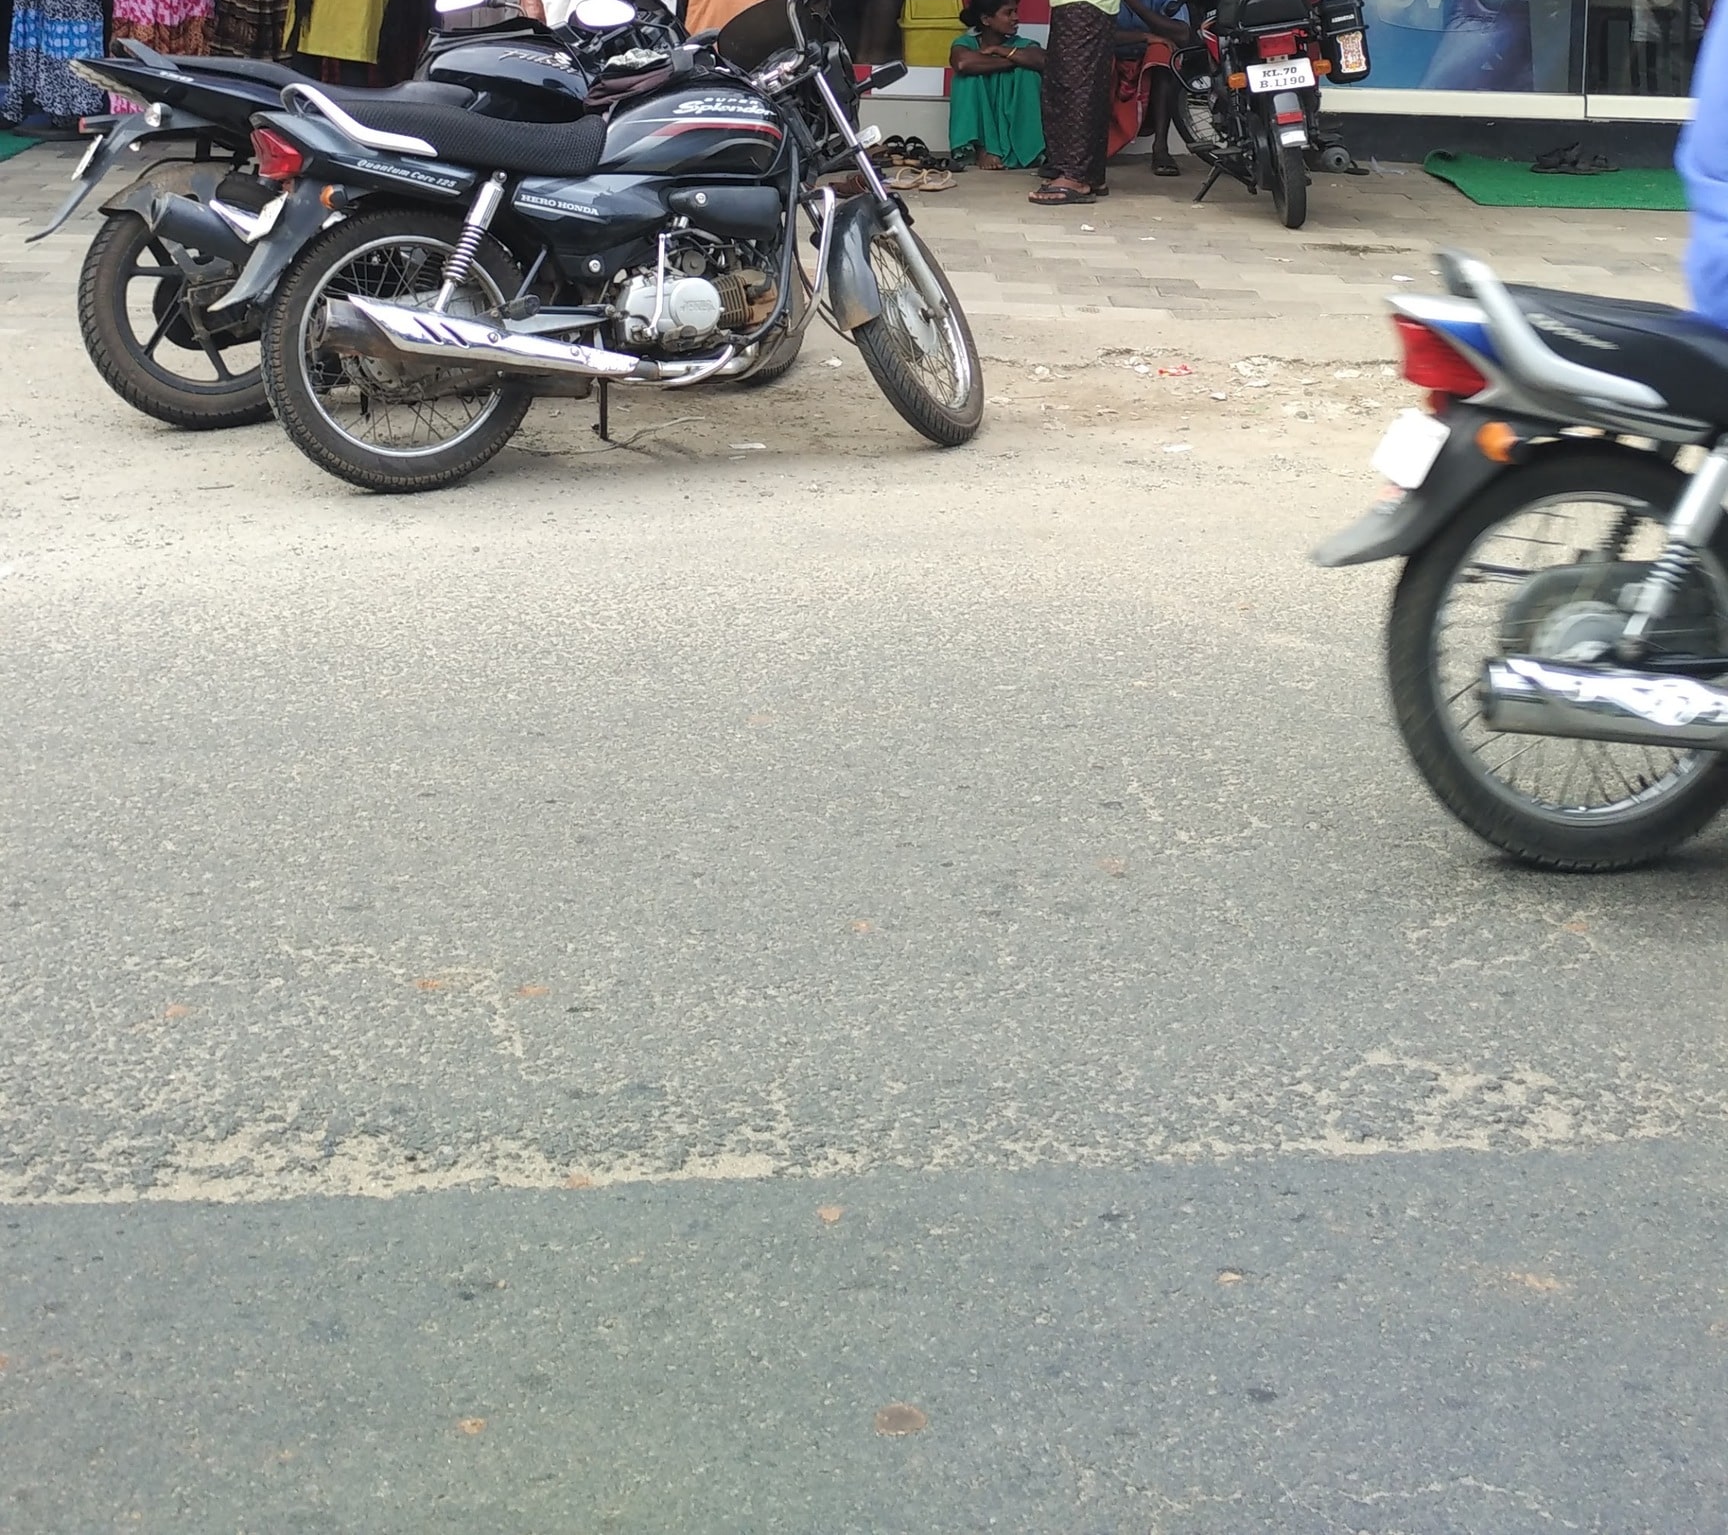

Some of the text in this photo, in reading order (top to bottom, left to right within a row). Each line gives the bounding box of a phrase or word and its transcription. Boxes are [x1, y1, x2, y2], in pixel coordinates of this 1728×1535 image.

[672, 100, 777, 116] Splendor
[704, 96, 759, 105] SUPER
[356, 158, 456, 188] Quantum Core 125
[520, 194, 600, 216] HERO HONDA
